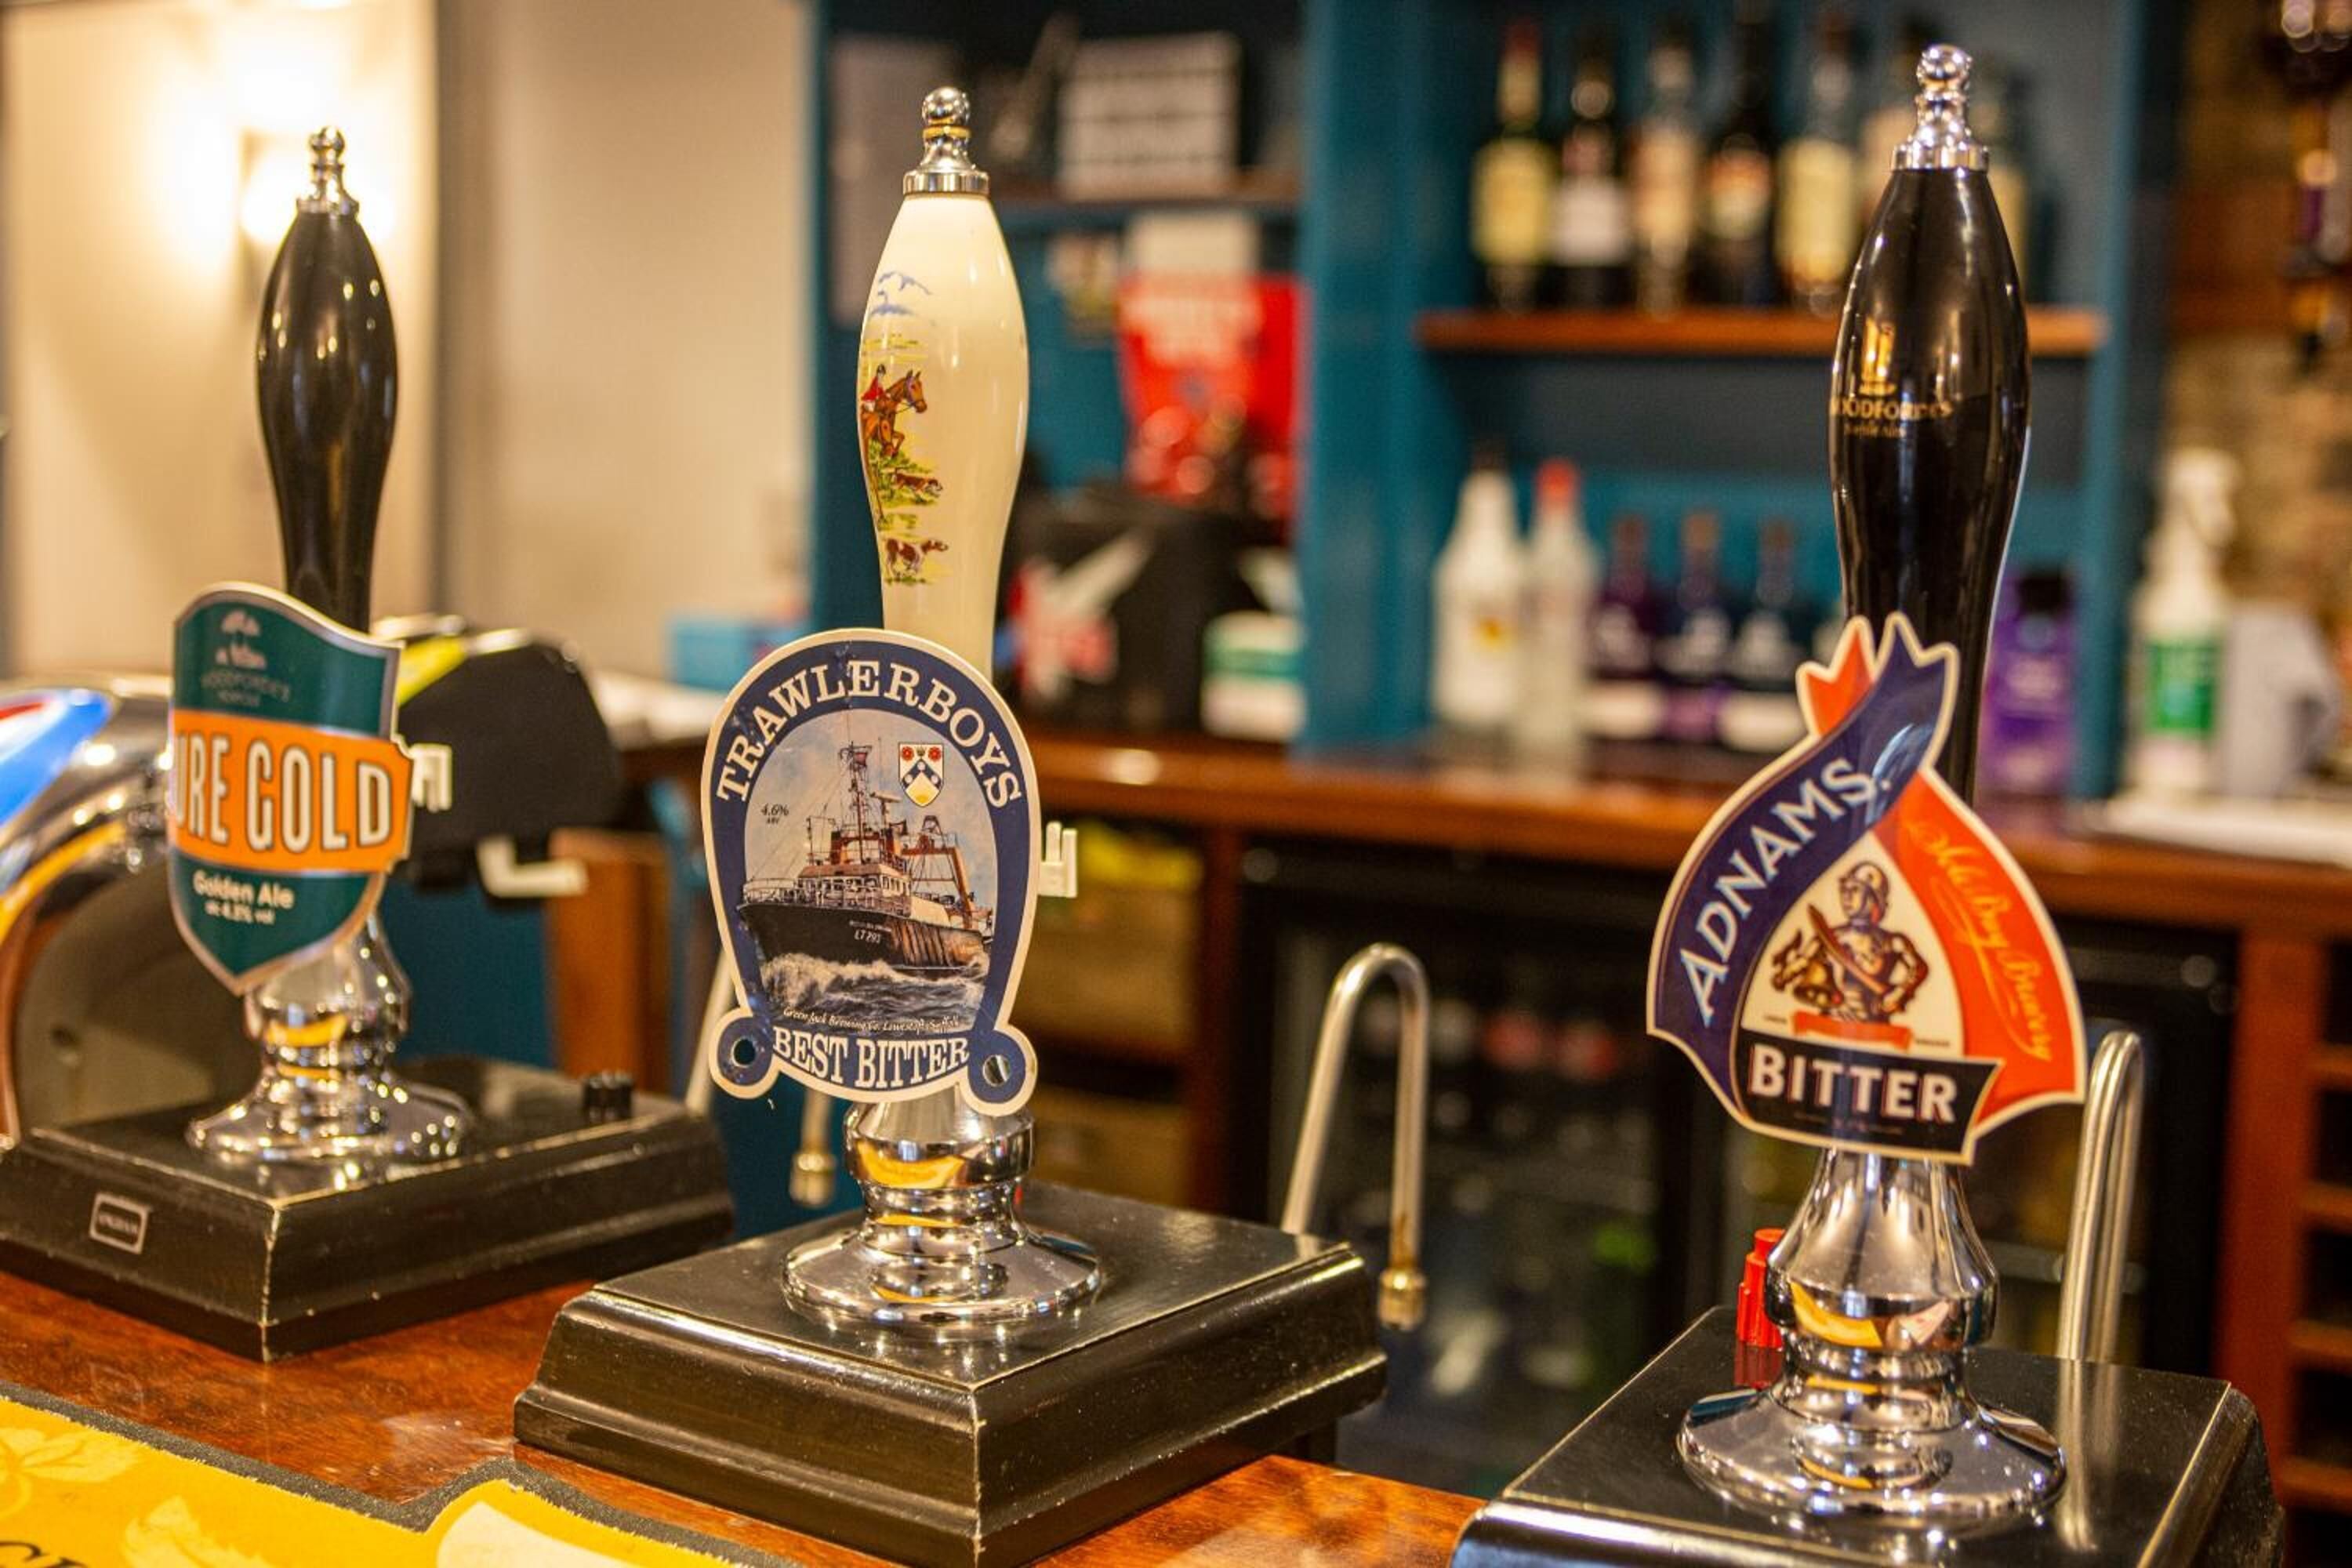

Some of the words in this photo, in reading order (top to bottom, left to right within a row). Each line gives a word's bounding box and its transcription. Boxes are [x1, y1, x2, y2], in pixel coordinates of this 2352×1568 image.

[717, 659, 1022, 808] TRAWLERBOYS
[174, 732, 230, 844] URE
[247, 739, 390, 852] GOLD
[193, 869, 255, 904] Golden
[256, 881, 295, 909] Ale
[1679, 757, 1878, 1028] ADNAMS
[772, 1025, 849, 1084] BEST
[854, 1036, 970, 1089] BITTER
[1748, 1043, 1958, 1123] BITTER
